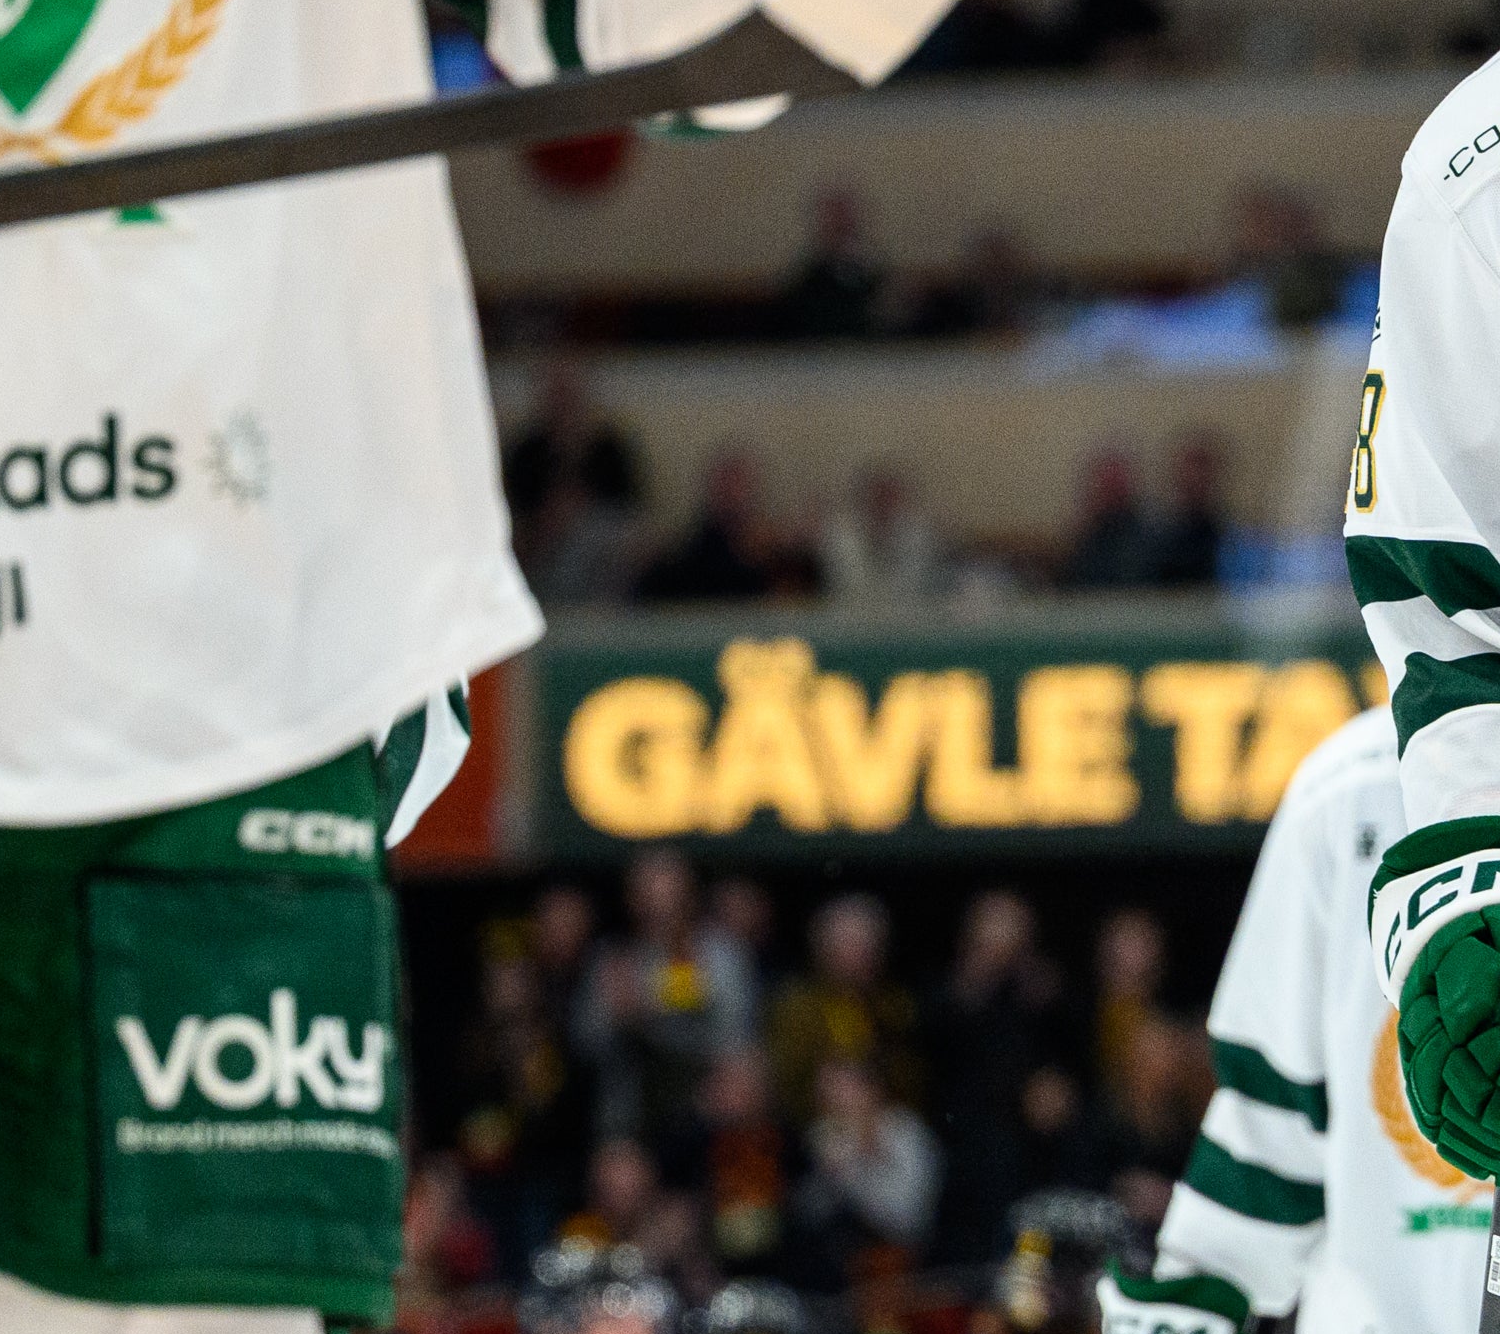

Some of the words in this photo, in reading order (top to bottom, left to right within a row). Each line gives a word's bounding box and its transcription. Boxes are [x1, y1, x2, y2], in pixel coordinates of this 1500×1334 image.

[562, 634, 1140, 841] GÄVLE
[1141, 657, 1390, 827] TA
[114, 986, 388, 1112] voky
